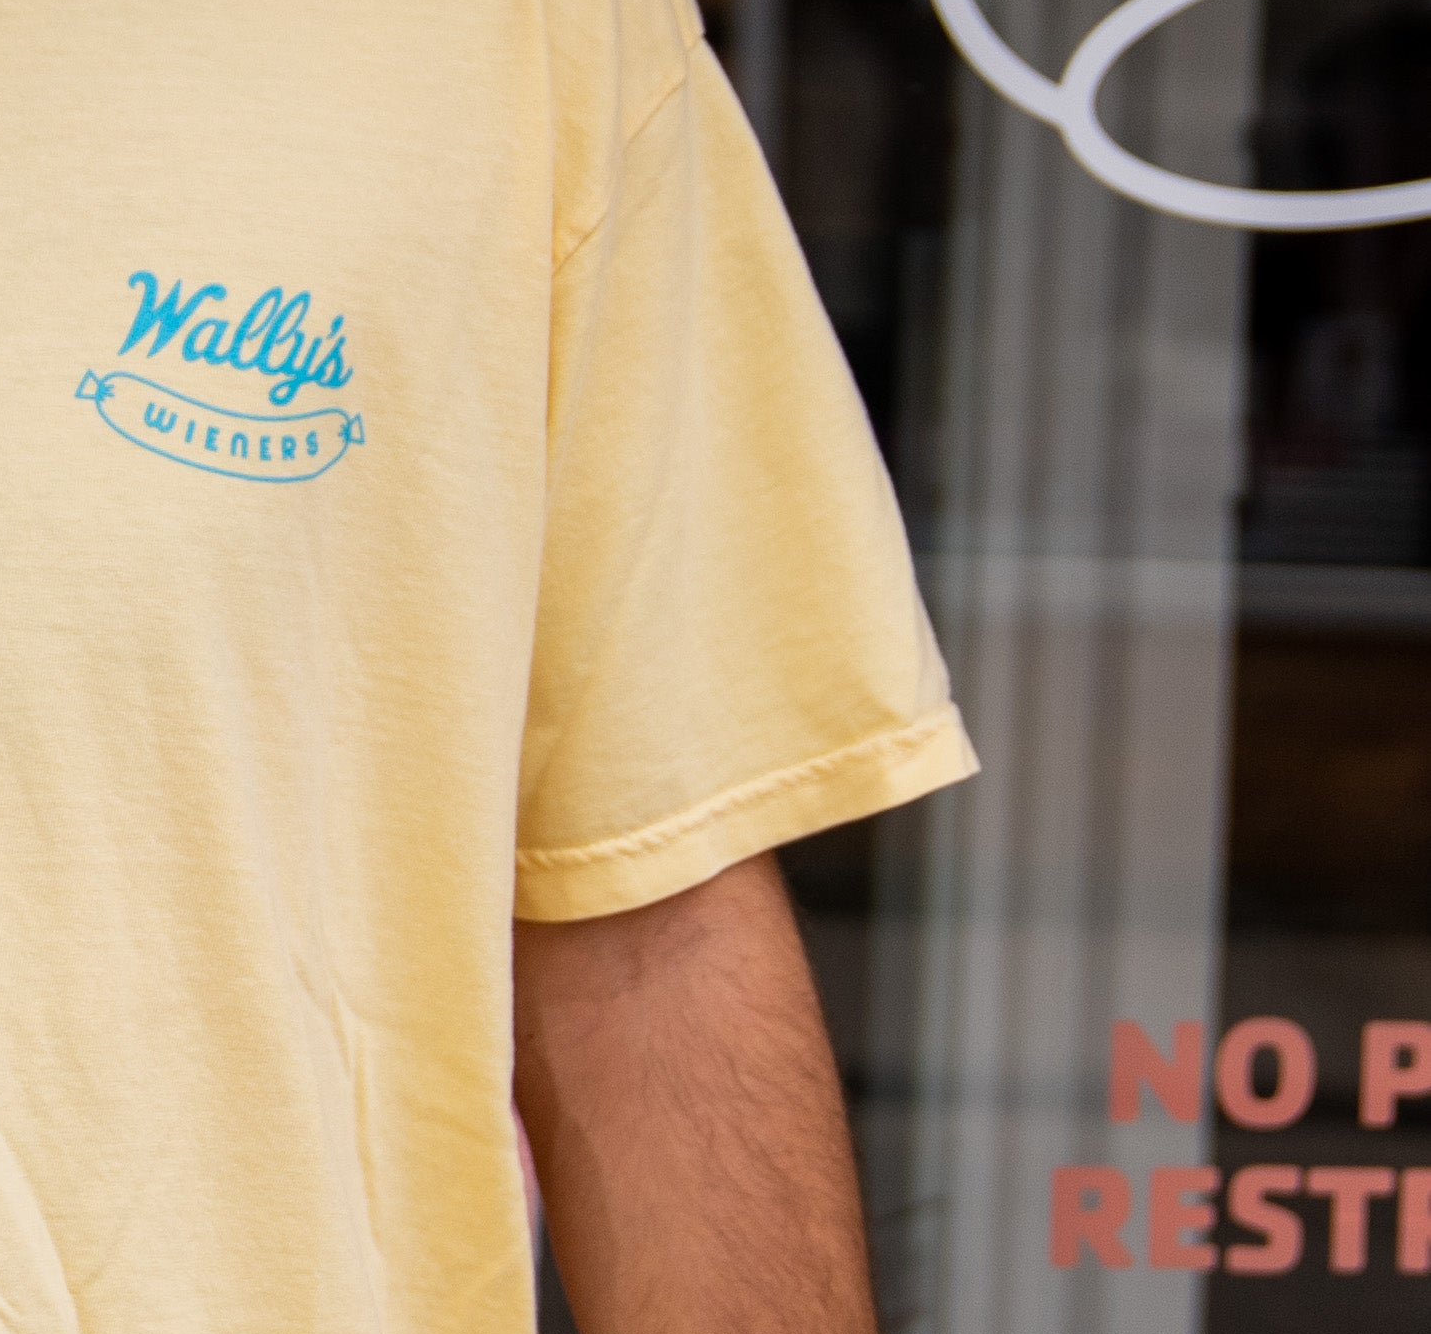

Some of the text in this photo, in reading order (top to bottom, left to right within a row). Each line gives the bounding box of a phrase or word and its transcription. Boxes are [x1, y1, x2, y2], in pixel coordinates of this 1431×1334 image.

[117, 270, 353, 405] Wally's
[143, 402, 319, 461] WIENERS
[1108, 1015, 1319, 1131] NO
